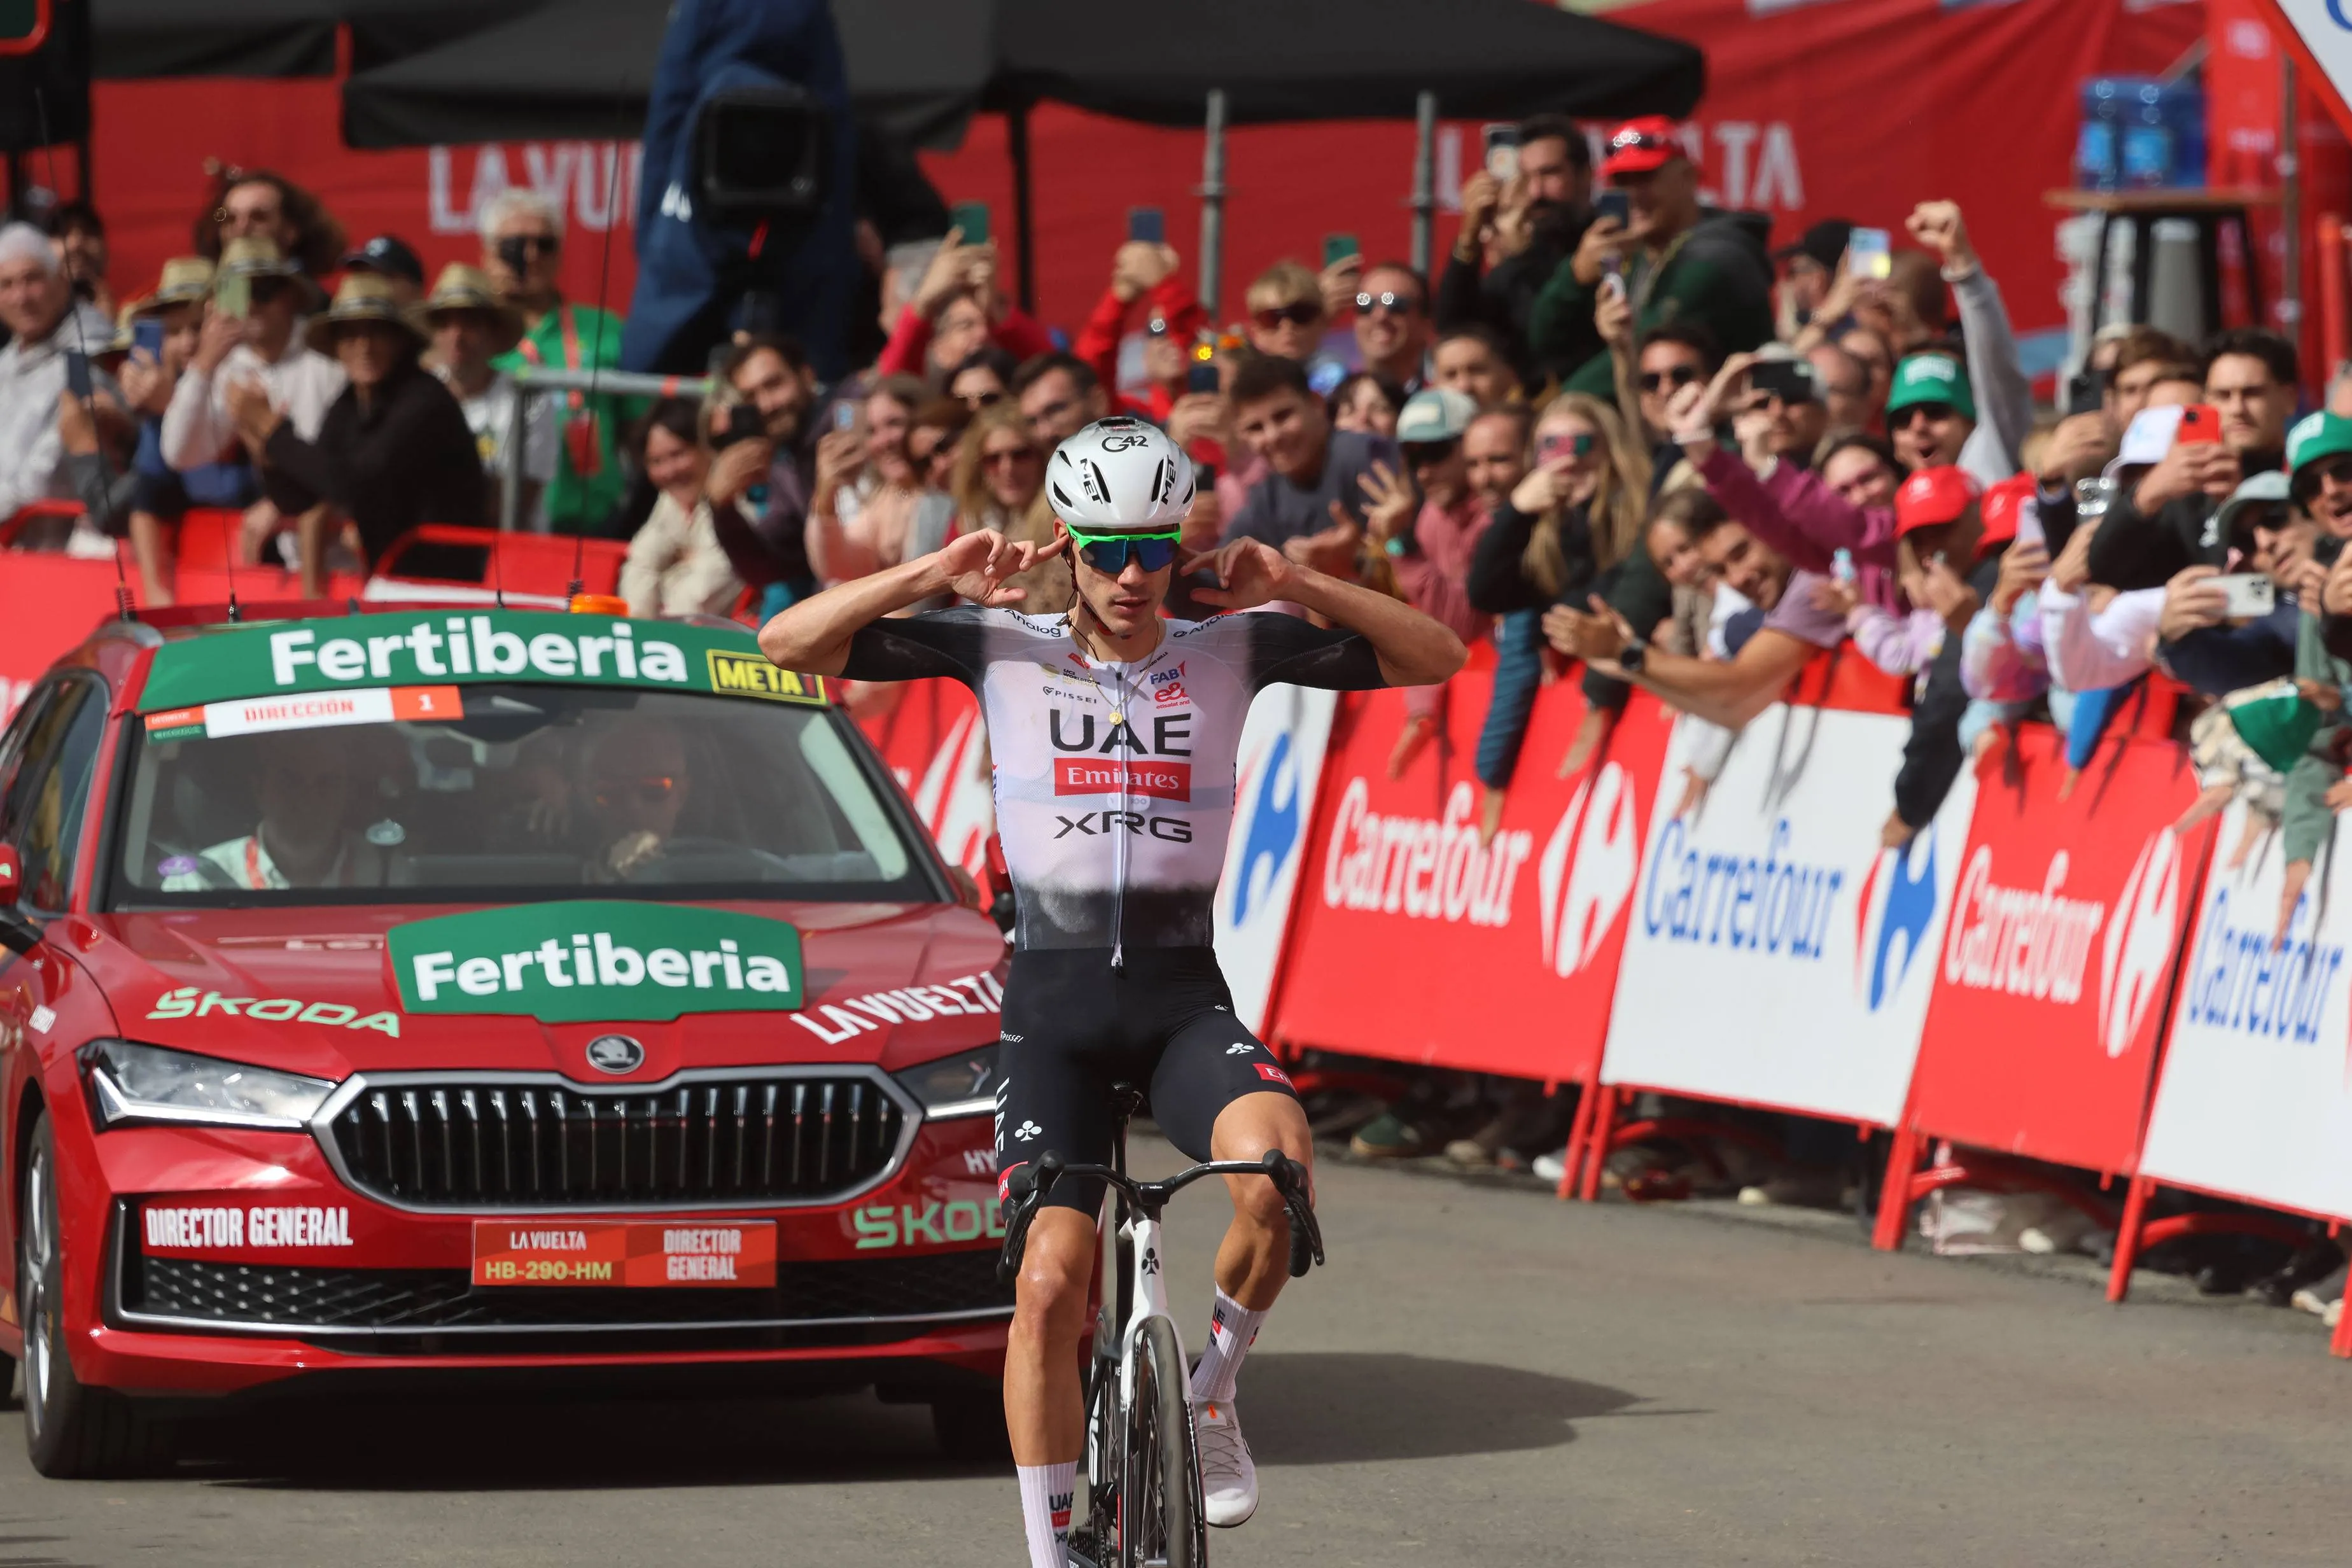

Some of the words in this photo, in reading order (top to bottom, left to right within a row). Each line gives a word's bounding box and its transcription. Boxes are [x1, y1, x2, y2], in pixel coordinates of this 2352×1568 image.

[1080, 458, 1103, 505] MET
[1161, 454, 1176, 505] MET
[1004, 609, 1061, 638] Analog
[270, 615, 689, 684] Fertiberia
[717, 658, 804, 696] META
[419, 694, 435, 711] 1
[1054, 690, 1097, 704] PISSEI
[1050, 709, 1192, 757] UAE
[1053, 810, 1193, 843] XRG
[1324, 776, 1532, 928] Carrefour
[1644, 818, 1843, 960] Carrefour
[1945, 844, 2105, 1004] Carrefour
[414, 933, 790, 1001] Fertiberia
[2189, 888, 2344, 1045] Carrefour
[789, 1005, 879, 1045] LA
[146, 1208, 243, 1247] DIRECTOR
[248, 1208, 353, 1247] GENERAL
[510, 1231, 528, 1250] LA
[530, 1231, 587, 1250] VUELTA
[664, 1229, 741, 1254] DIRECTOR
[485, 1261, 612, 1280] HB-290-HM
[667, 1256, 738, 1280] GENERAL
